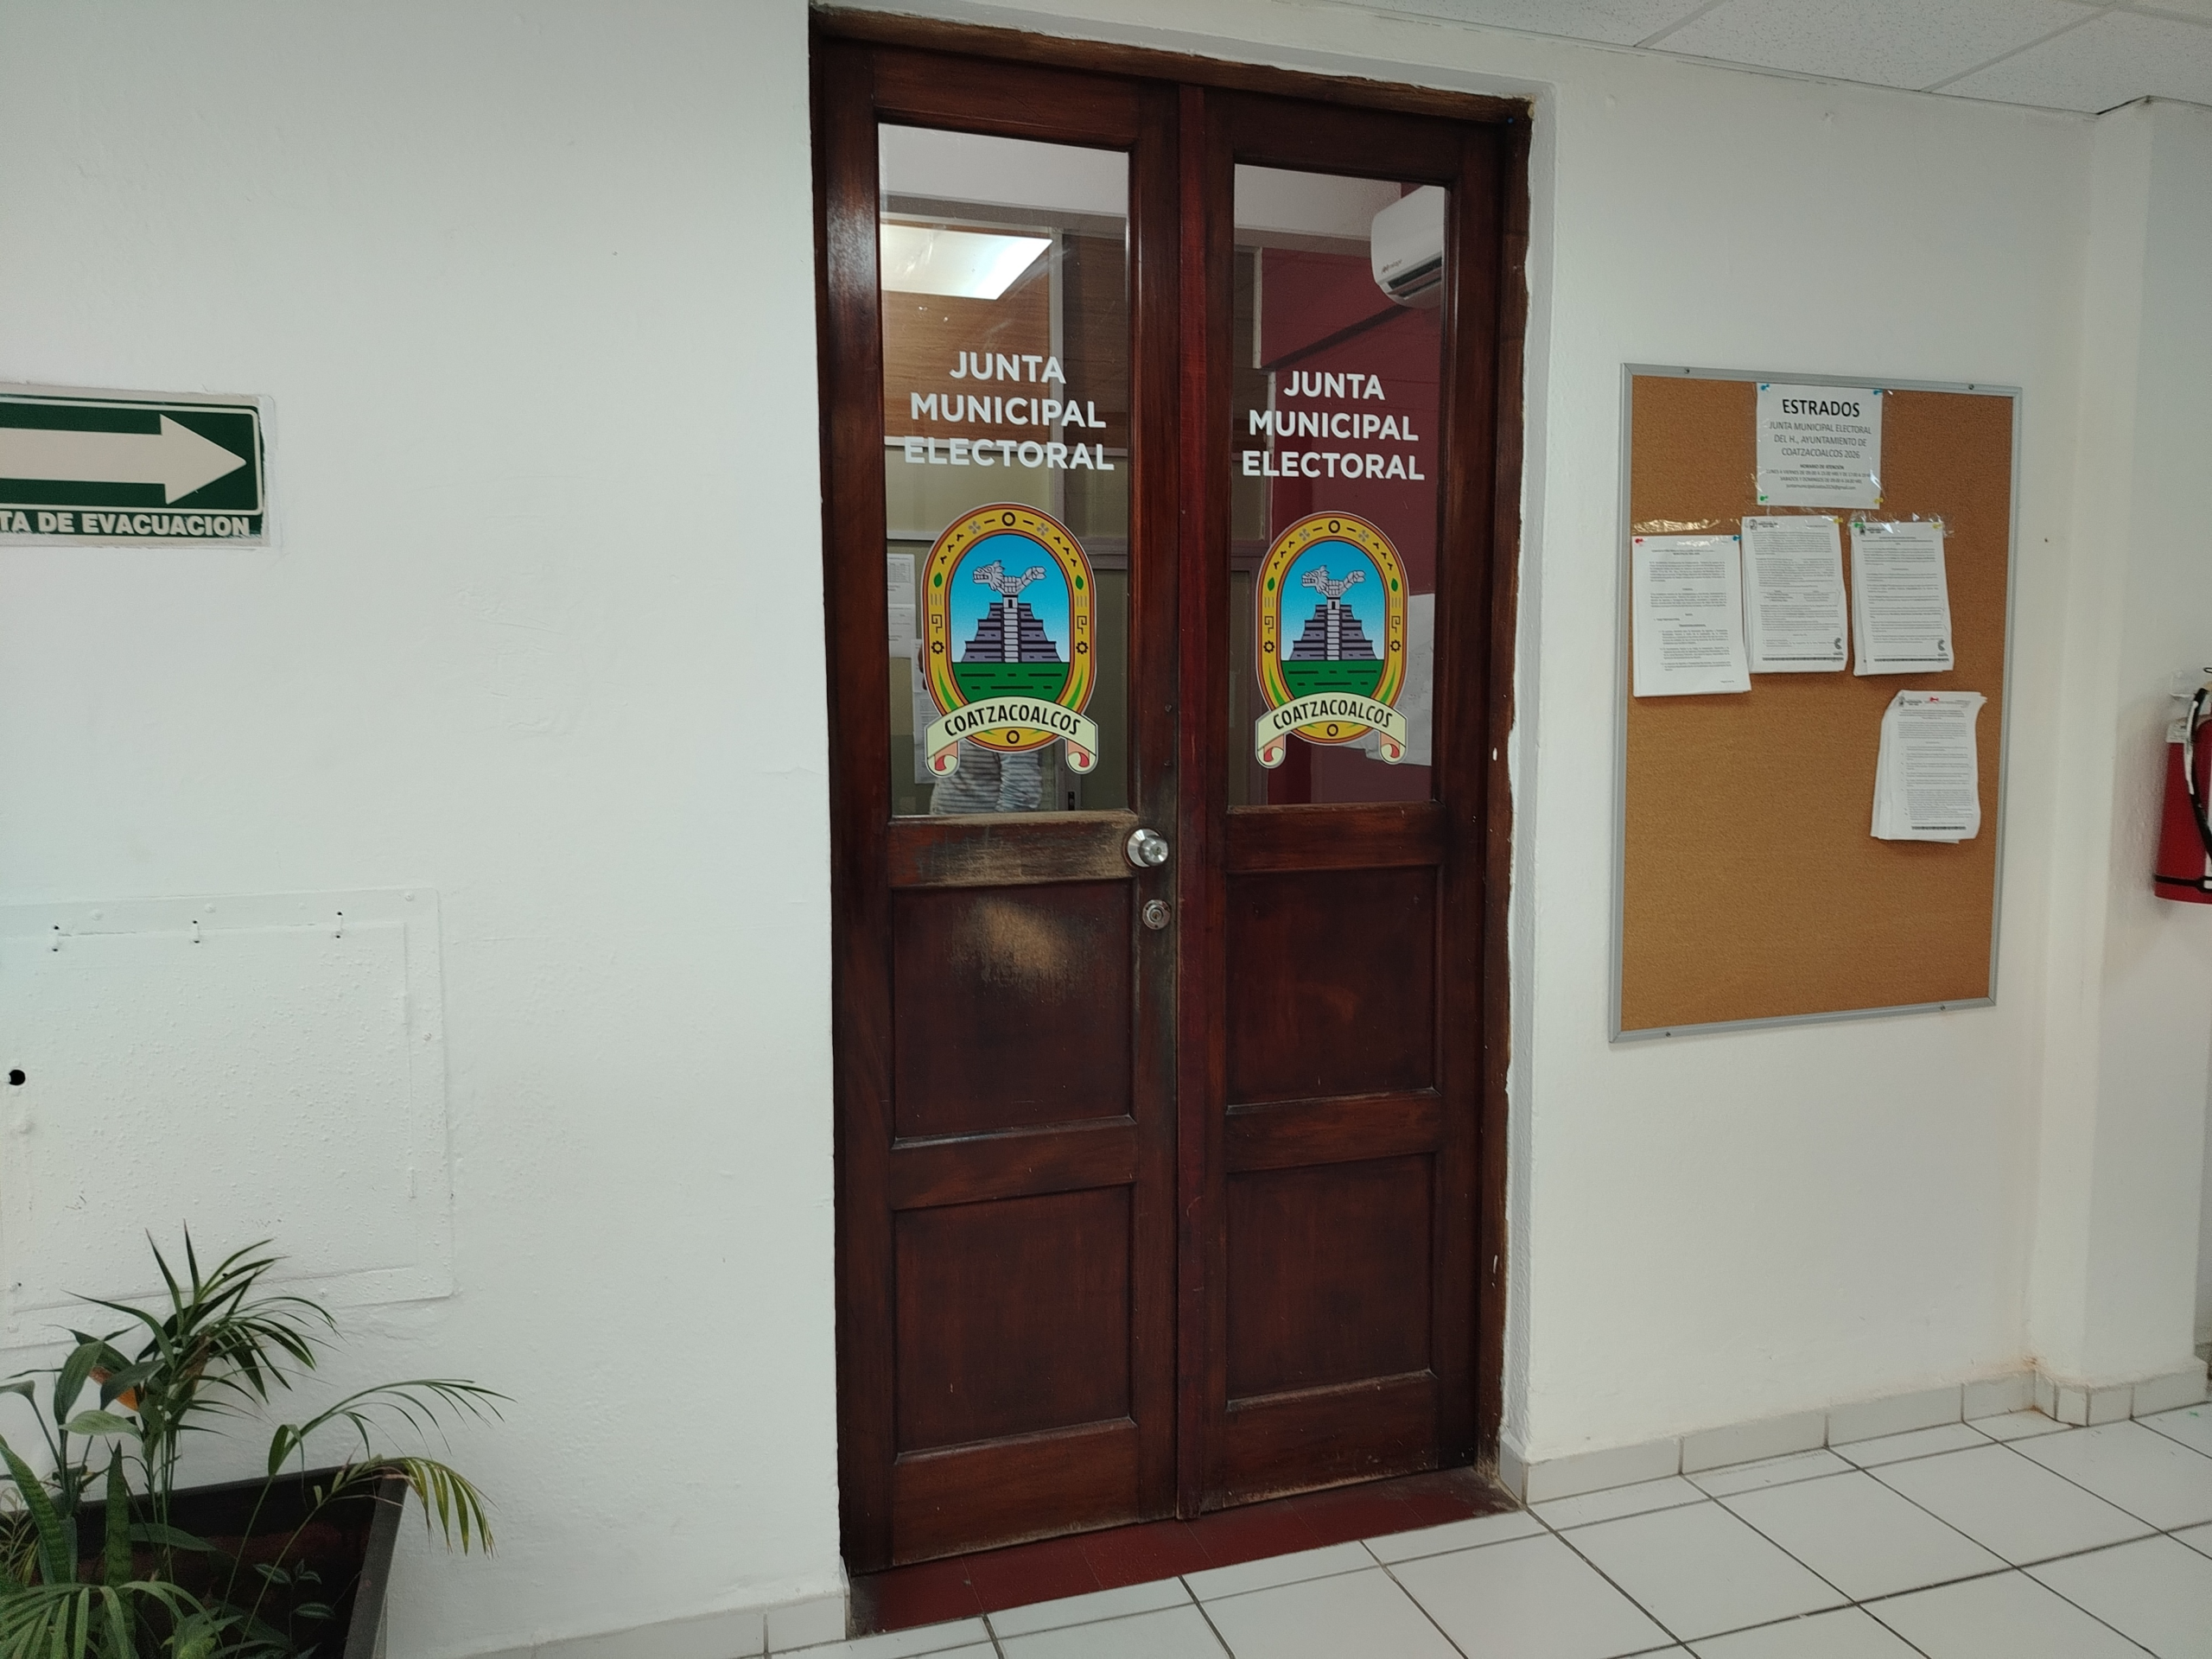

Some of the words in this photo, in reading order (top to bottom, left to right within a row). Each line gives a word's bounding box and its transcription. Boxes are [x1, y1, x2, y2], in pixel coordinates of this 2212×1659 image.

[949, 351, 1067, 385] JUNTA
[1283, 370, 1386, 401] JUNTA
[910, 391, 1107, 429] MUNICIPAL
[1782, 398, 1860, 417] ESTRADOS
[1249, 409, 1420, 442] MUNICIPAL
[1769, 421, 1793, 430] JUNTA
[1794, 422, 1834, 432] MUNICIPAL
[1835, 423, 1872, 435] ELECTORAL
[1774, 434, 1788, 443] DEL
[1801, 435, 1857, 446] AYUNTAMIENTO
[1858, 438, 1867, 447] DE
[904, 435, 1115, 471] ELECTORAL
[1242, 449, 1426, 480] ELECTORAL
[1781, 448, 1843, 458] COATZACOALCOS
[37, 512, 74, 533] DE
[81, 513, 251, 537] EVACUACION
[944, 704, 1081, 736] COATZACOALCOS
[1273, 699, 1393, 730] COATZACOALCOS
